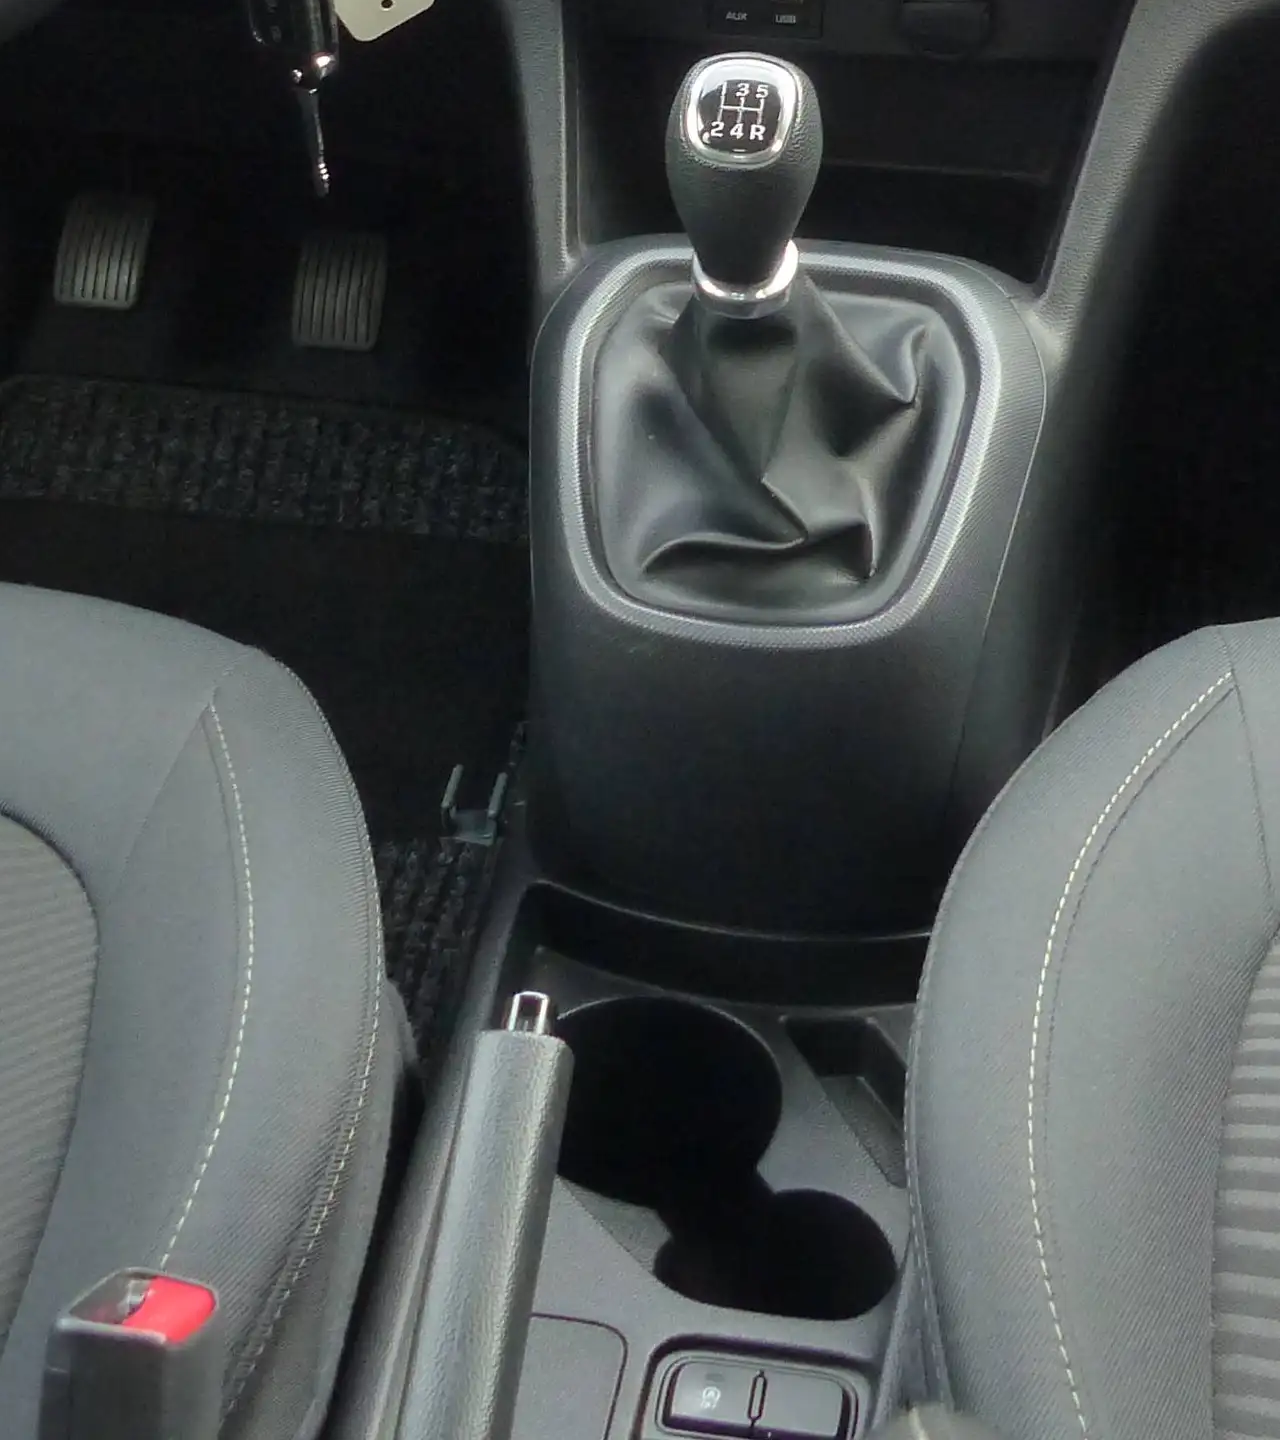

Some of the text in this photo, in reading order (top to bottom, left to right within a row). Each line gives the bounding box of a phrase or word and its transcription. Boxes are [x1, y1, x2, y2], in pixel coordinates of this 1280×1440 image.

[725, 11, 749, 21] AUX
[735, 82, 750, 98] 3
[755, 84, 769, 99] 5
[710, 120, 766, 141] 2 4 R
